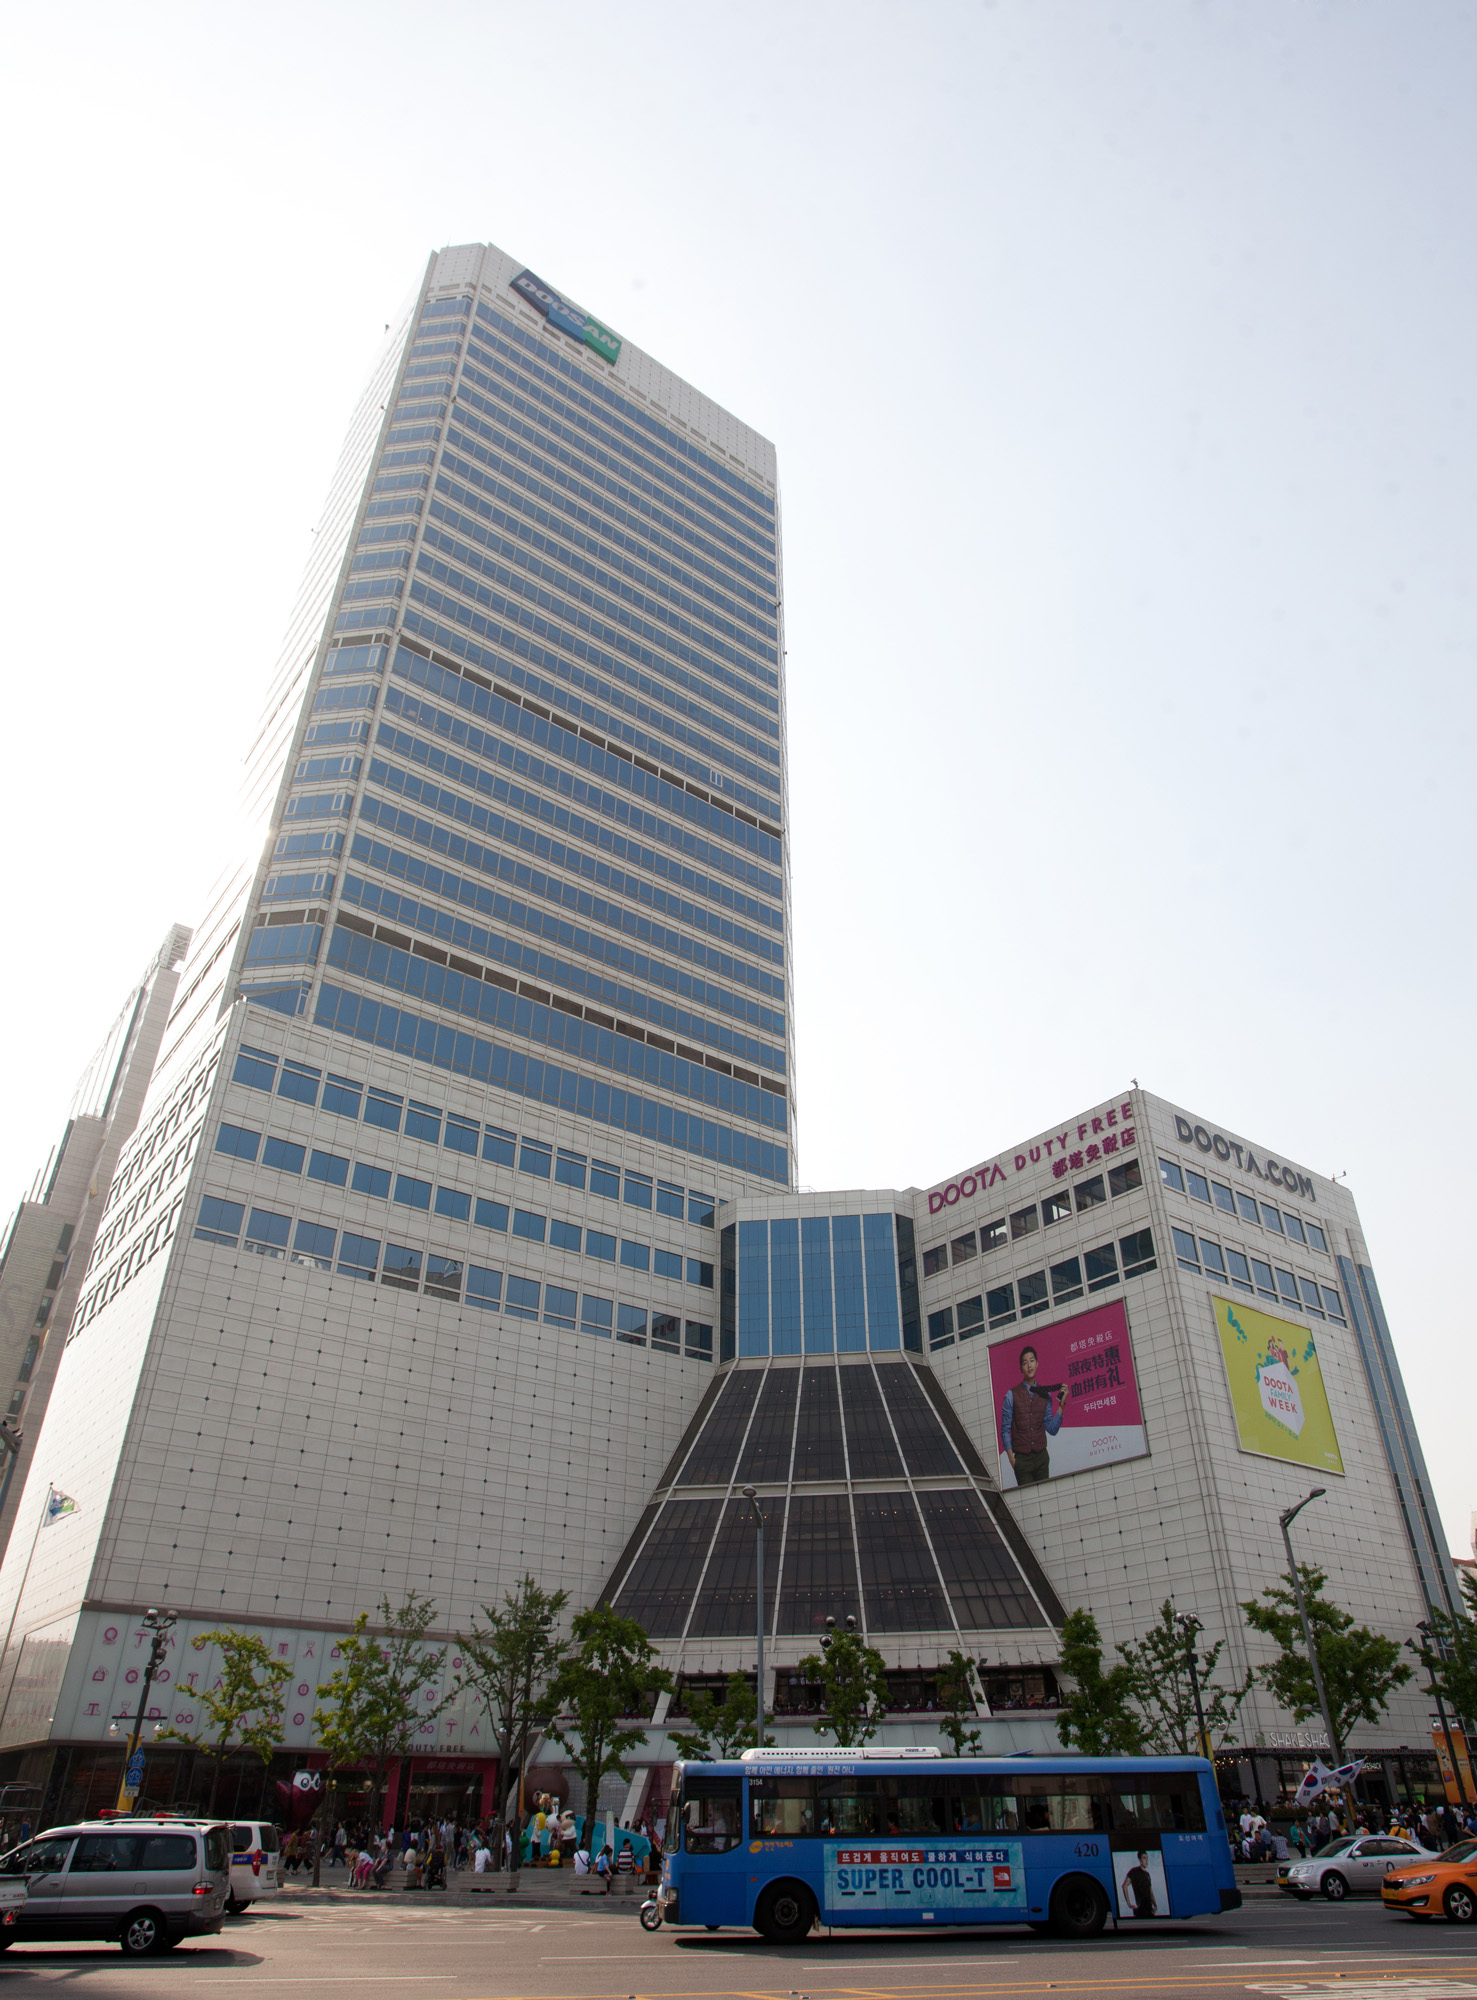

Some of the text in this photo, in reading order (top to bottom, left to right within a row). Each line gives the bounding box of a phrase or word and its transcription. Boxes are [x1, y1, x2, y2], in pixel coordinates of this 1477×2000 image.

[517, 277, 619, 350] DOOSAN
[928, 1102, 1133, 1214] DOOTA DUTY FREE
[1174, 1114, 1317, 1202] DOOTA.COM
[1068, 1345, 1121, 1378] 深夜特惠
[1071, 1365, 1125, 1397] 血拼有礼
[1263, 1376, 1294, 1394] DOOTA
[1271, 1388, 1292, 1401] FAMILY
[1083, 1395, 1116, 1412] 두타면세점
[1268, 1396, 1298, 1414] WEEK
[1092, 1435, 1118, 1448] DOOTA
[1089, 1444, 1121, 1456] DUTY FREE
[408, 1744, 465, 1752] DUTY FREE
[1304, 1732, 1331, 1748] SHAC
[745, 1765, 758, 1775] 함께
[796, 1765, 809, 1775] 함께
[842, 1765, 855, 1775] 하나
[749, 1778, 763, 1786] 3154
[841, 1852, 872, 1863] 뜨겁게
[879, 1852, 920, 1863] 움직여도
[964, 1851, 1005, 1862] 식혀준다
[1074, 1842, 1099, 1857] 420
[837, 1868, 905, 1890] SUPER
[913, 1867, 985, 1889] COOL-T
